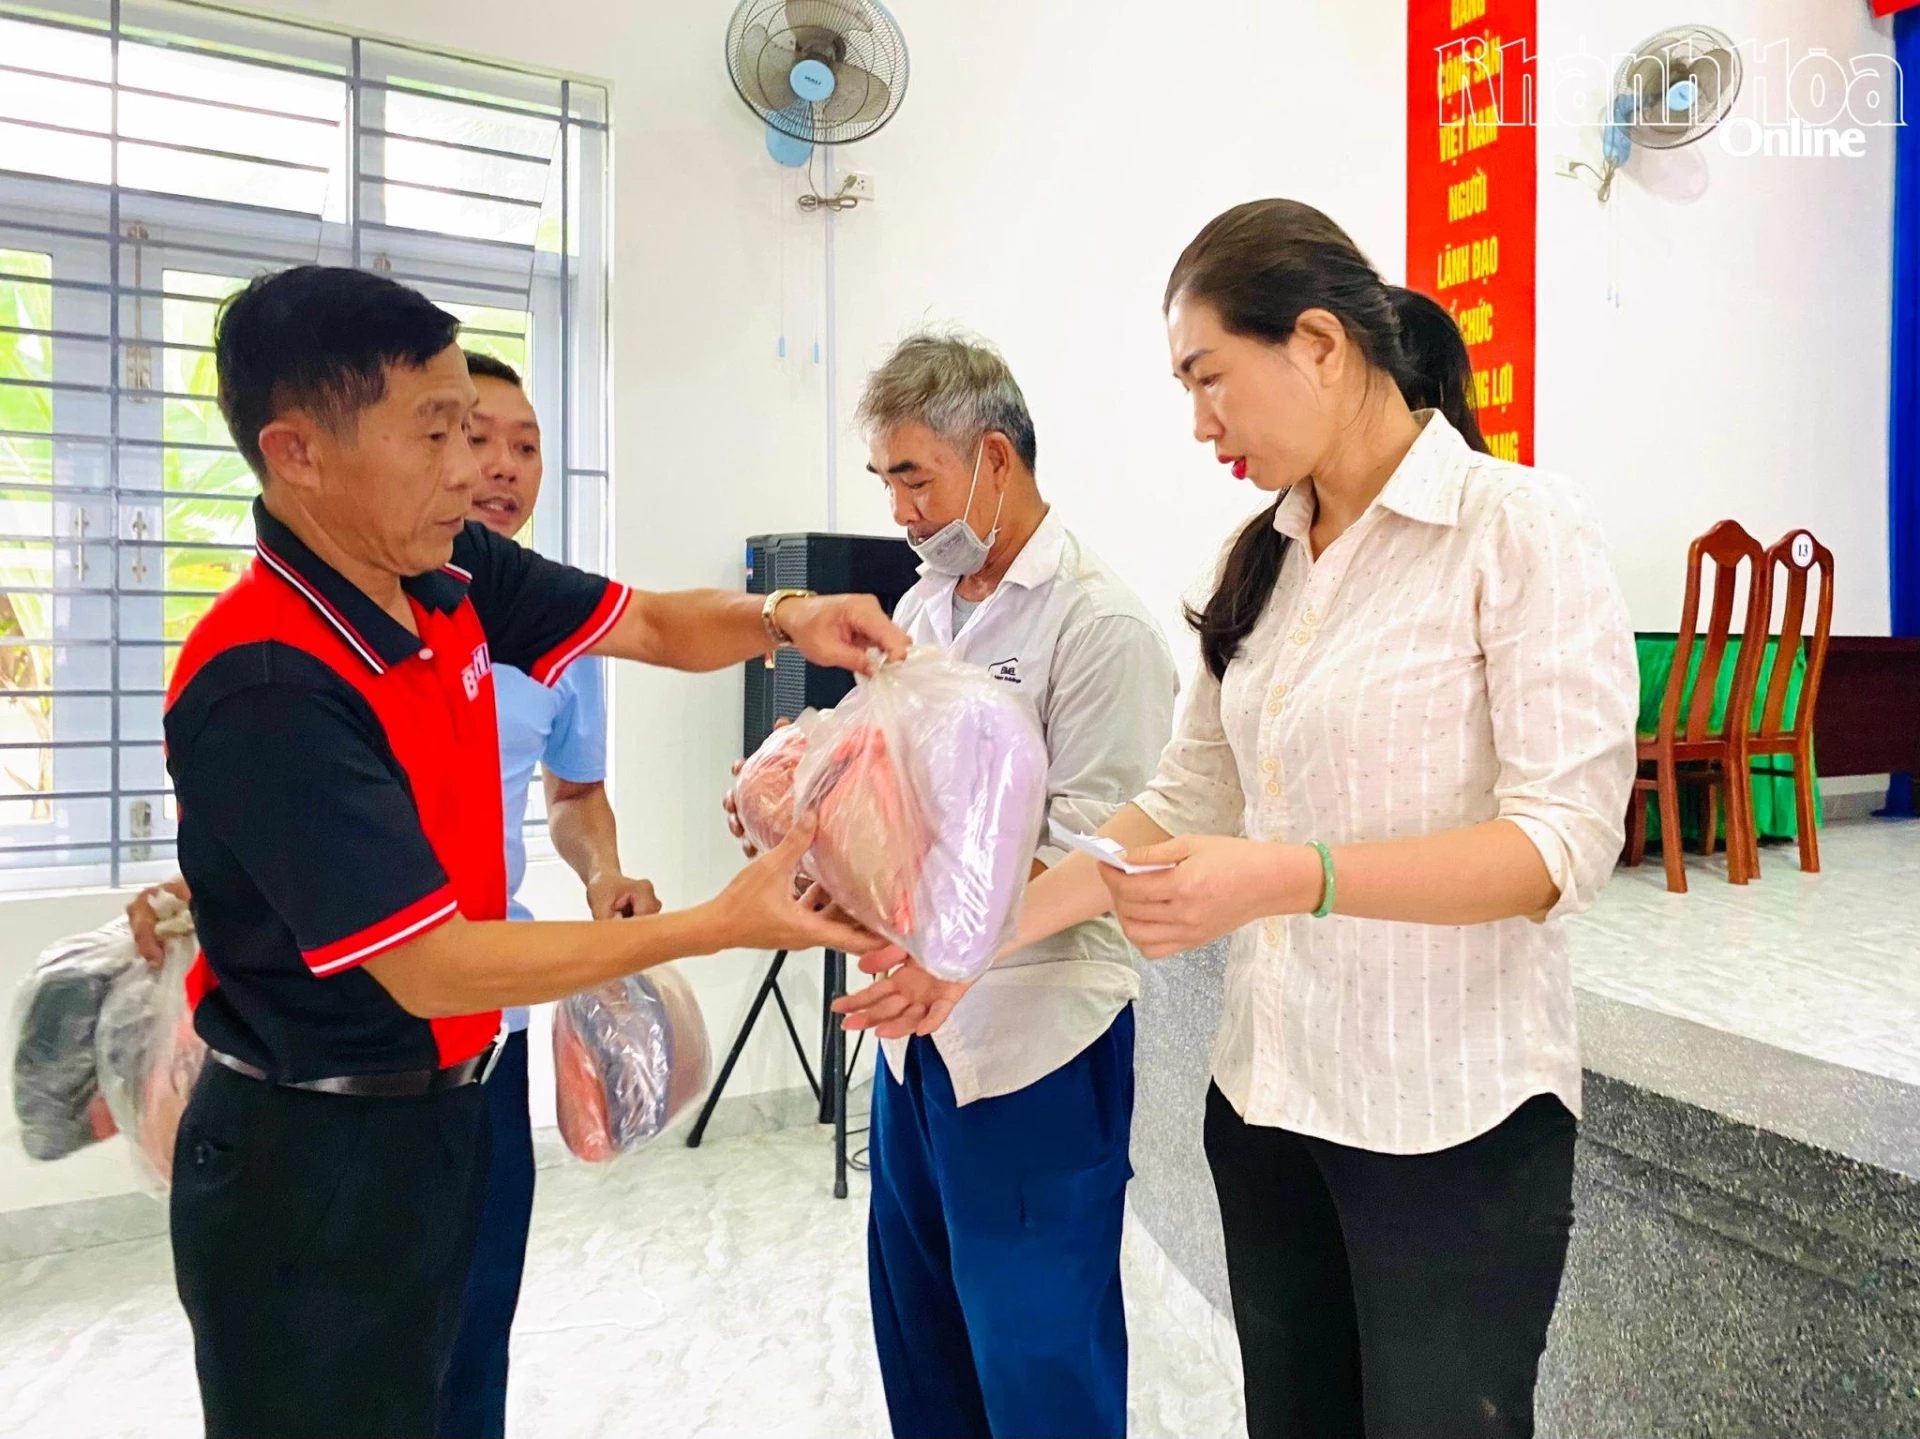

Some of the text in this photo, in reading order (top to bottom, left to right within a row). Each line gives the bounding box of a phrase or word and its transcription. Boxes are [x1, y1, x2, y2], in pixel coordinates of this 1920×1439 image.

[1439, 104, 1498, 166] VIỆT NAM
[1448, 167, 1487, 223] NGƯỜI
[1437, 235, 1498, 290] LÃNH ĐẠO
[1492, 362, 1513, 413] LỢI
[1798, 544, 1808, 557] 13
